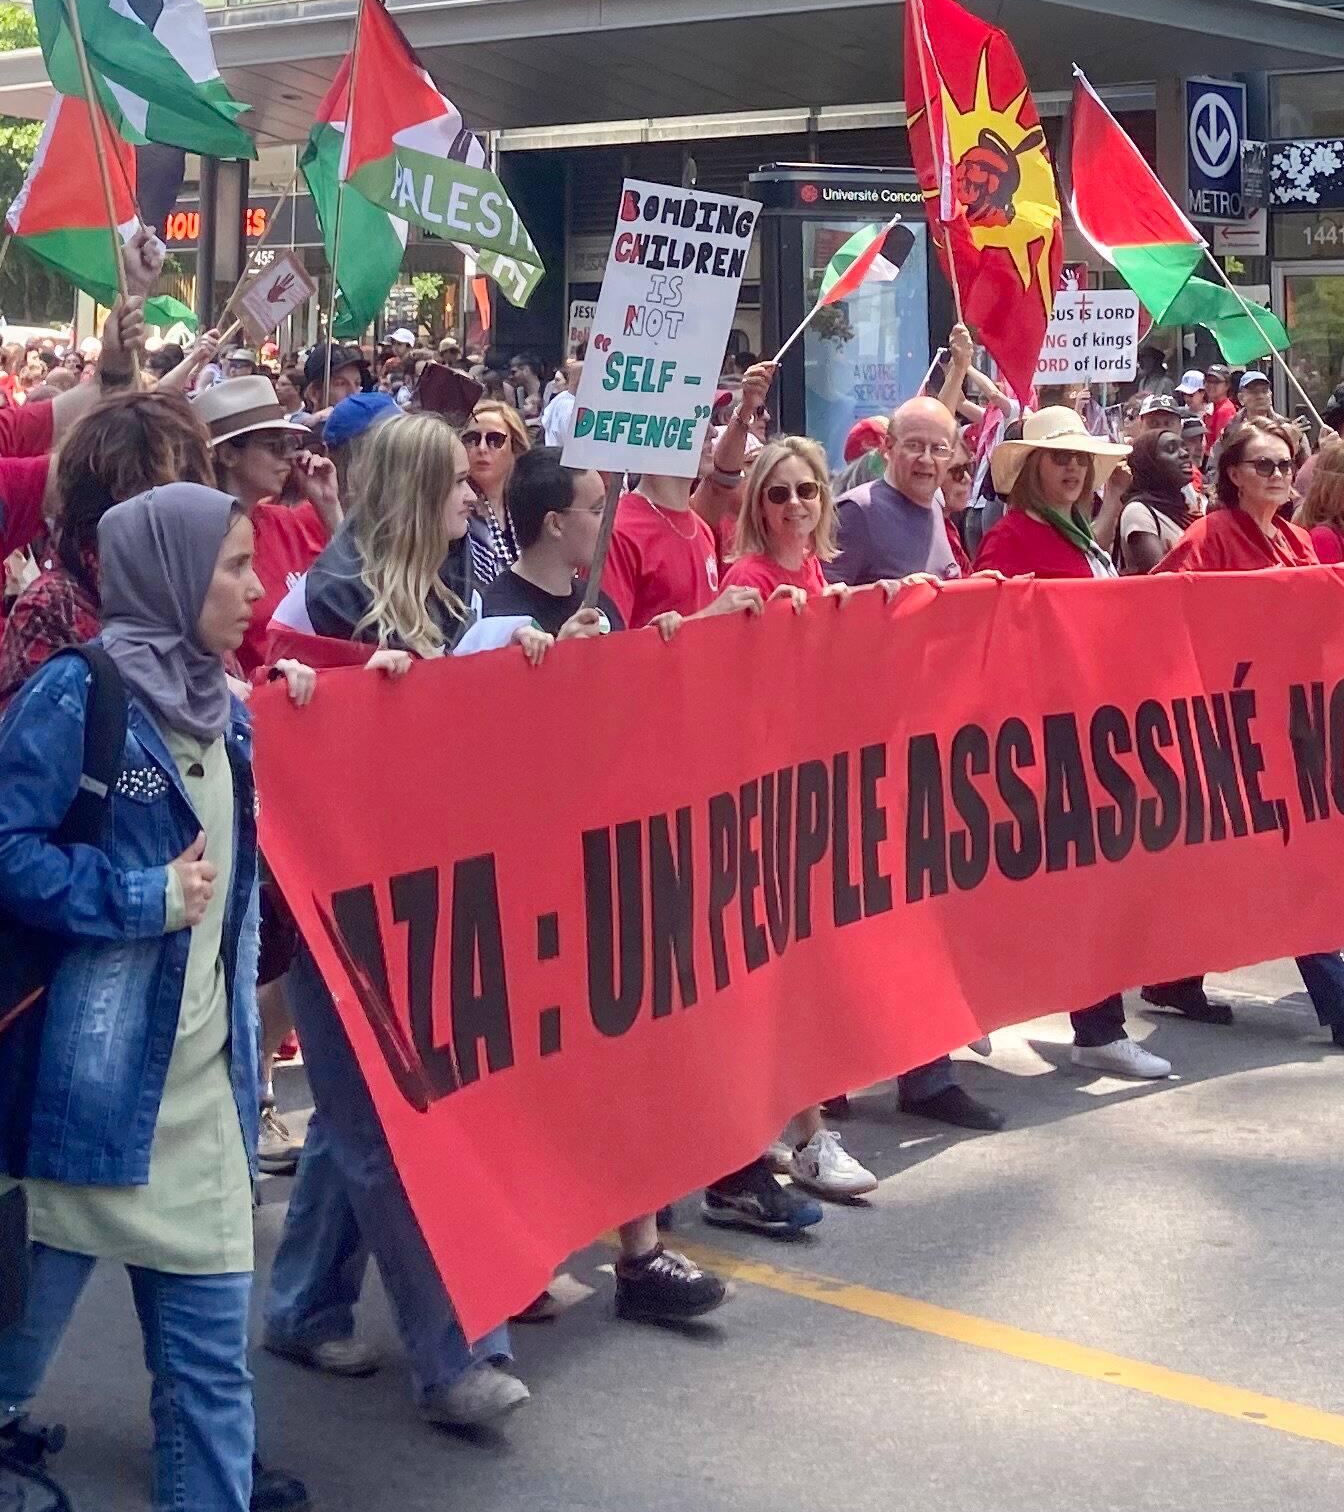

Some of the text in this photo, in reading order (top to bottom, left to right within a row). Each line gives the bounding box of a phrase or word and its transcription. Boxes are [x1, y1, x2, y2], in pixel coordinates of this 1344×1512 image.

[822, 188, 925, 203] Université Concor
[620, 190, 754, 238] BOMBING
[615, 232, 747, 278] CHILDREN
[646, 274, 684, 307] IS
[623, 305, 684, 339] NOT
[1079, 309, 1092, 320] IS
[1096, 307, 1135, 320] LORD
[1046, 332, 1132, 350] NG of kings
[1035, 355, 1131, 373] ORD of lords
[582, 806, 697, 1037] UN
[709, 742, 894, 991] PEUPLE
[905, 661, 1290, 904] ASSASSINÉ,
